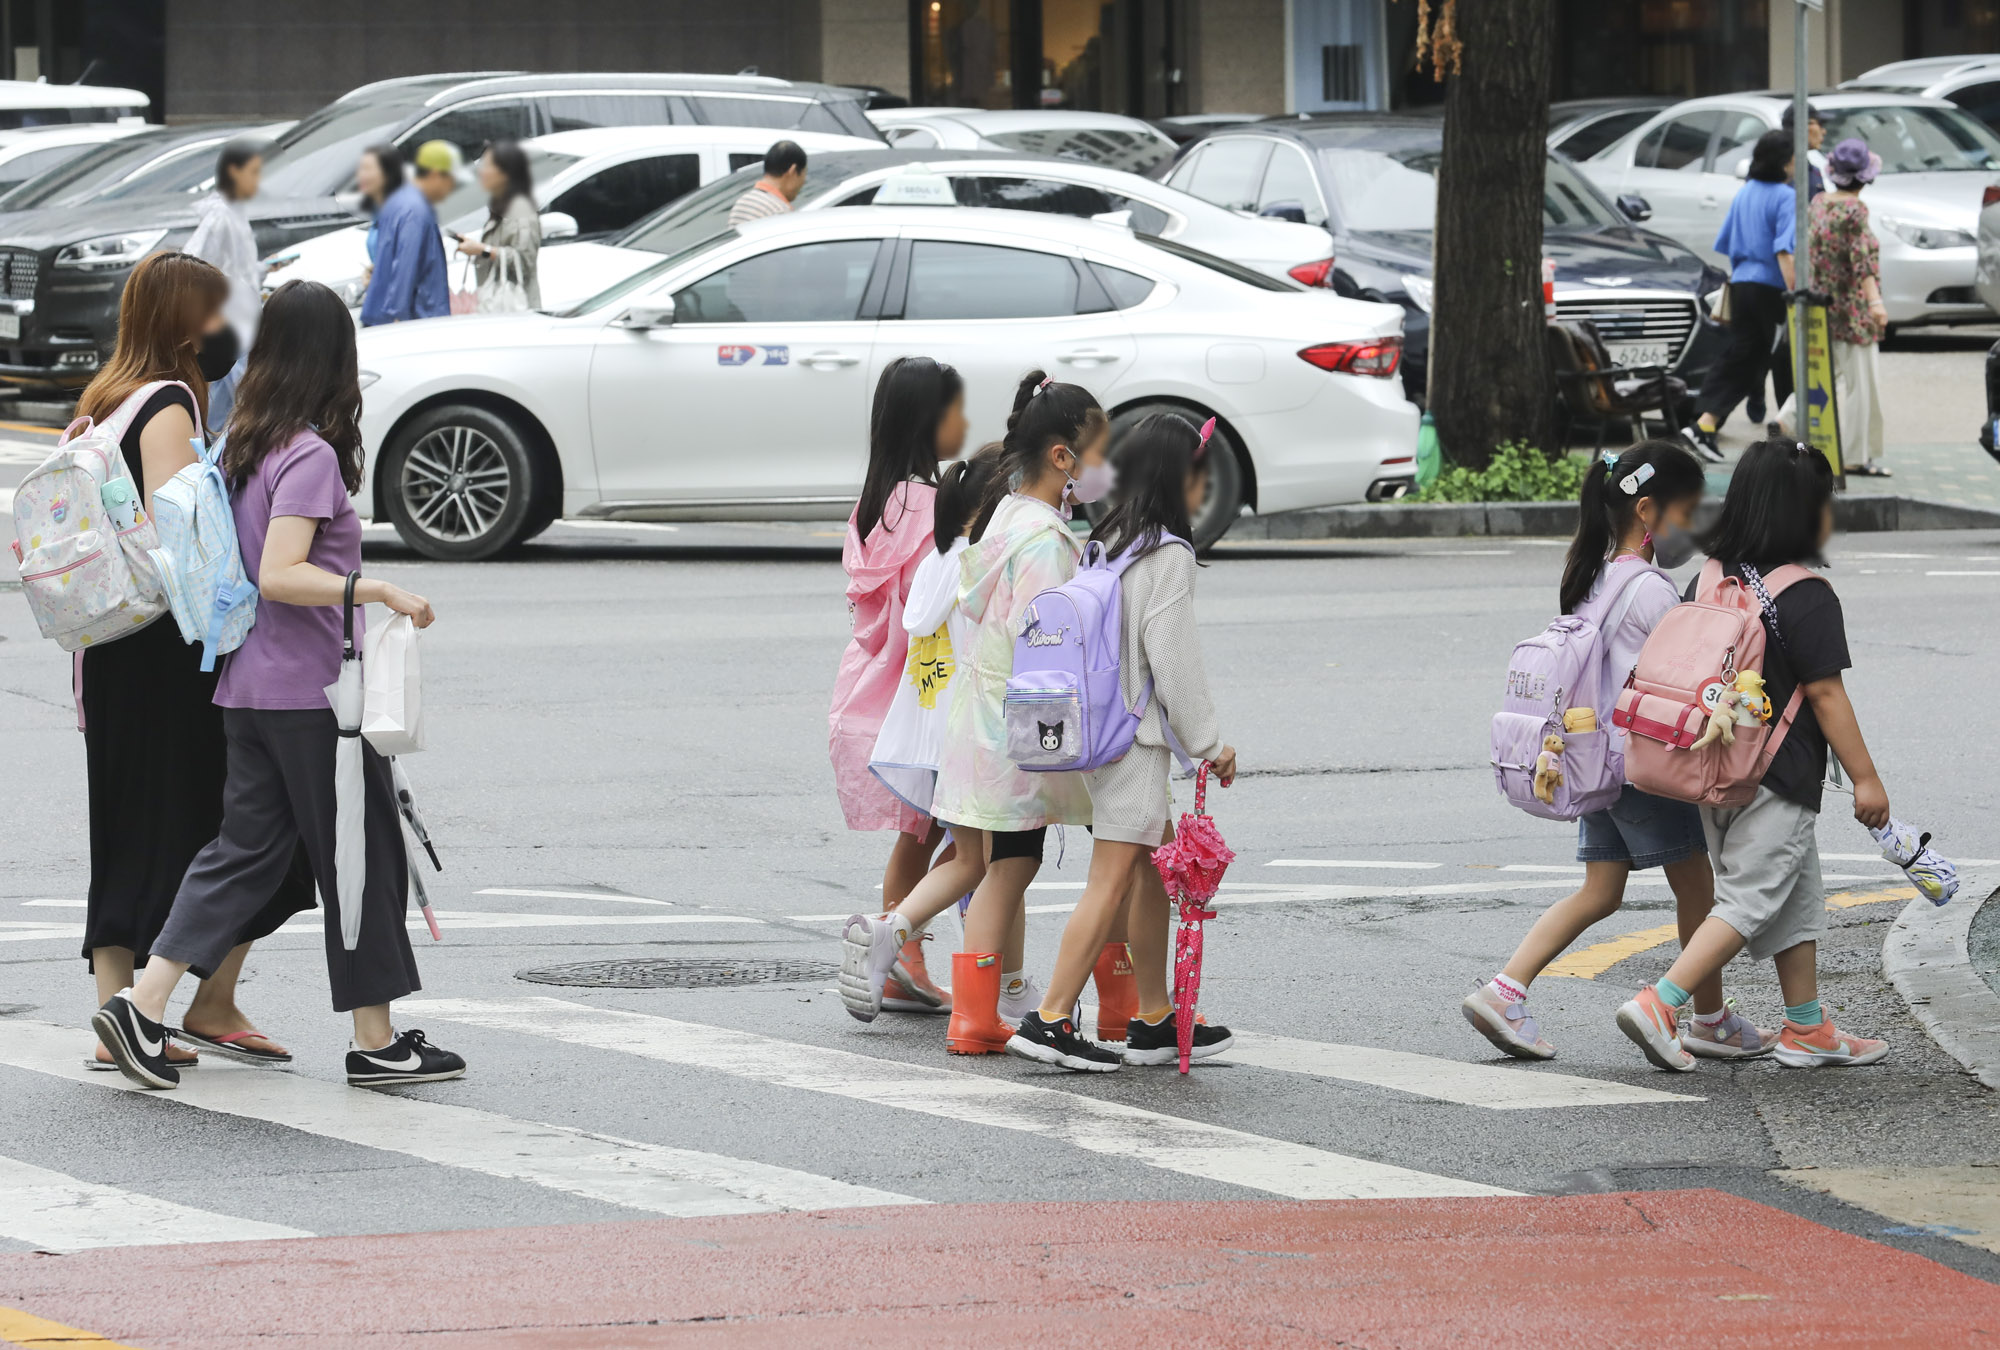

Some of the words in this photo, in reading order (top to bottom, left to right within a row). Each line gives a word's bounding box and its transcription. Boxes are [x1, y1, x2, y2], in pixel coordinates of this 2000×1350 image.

[1620, 347, 1660, 363] 6266
[1028, 628, 1063, 648] Kuromi
[1506, 670, 1546, 701] POLO
